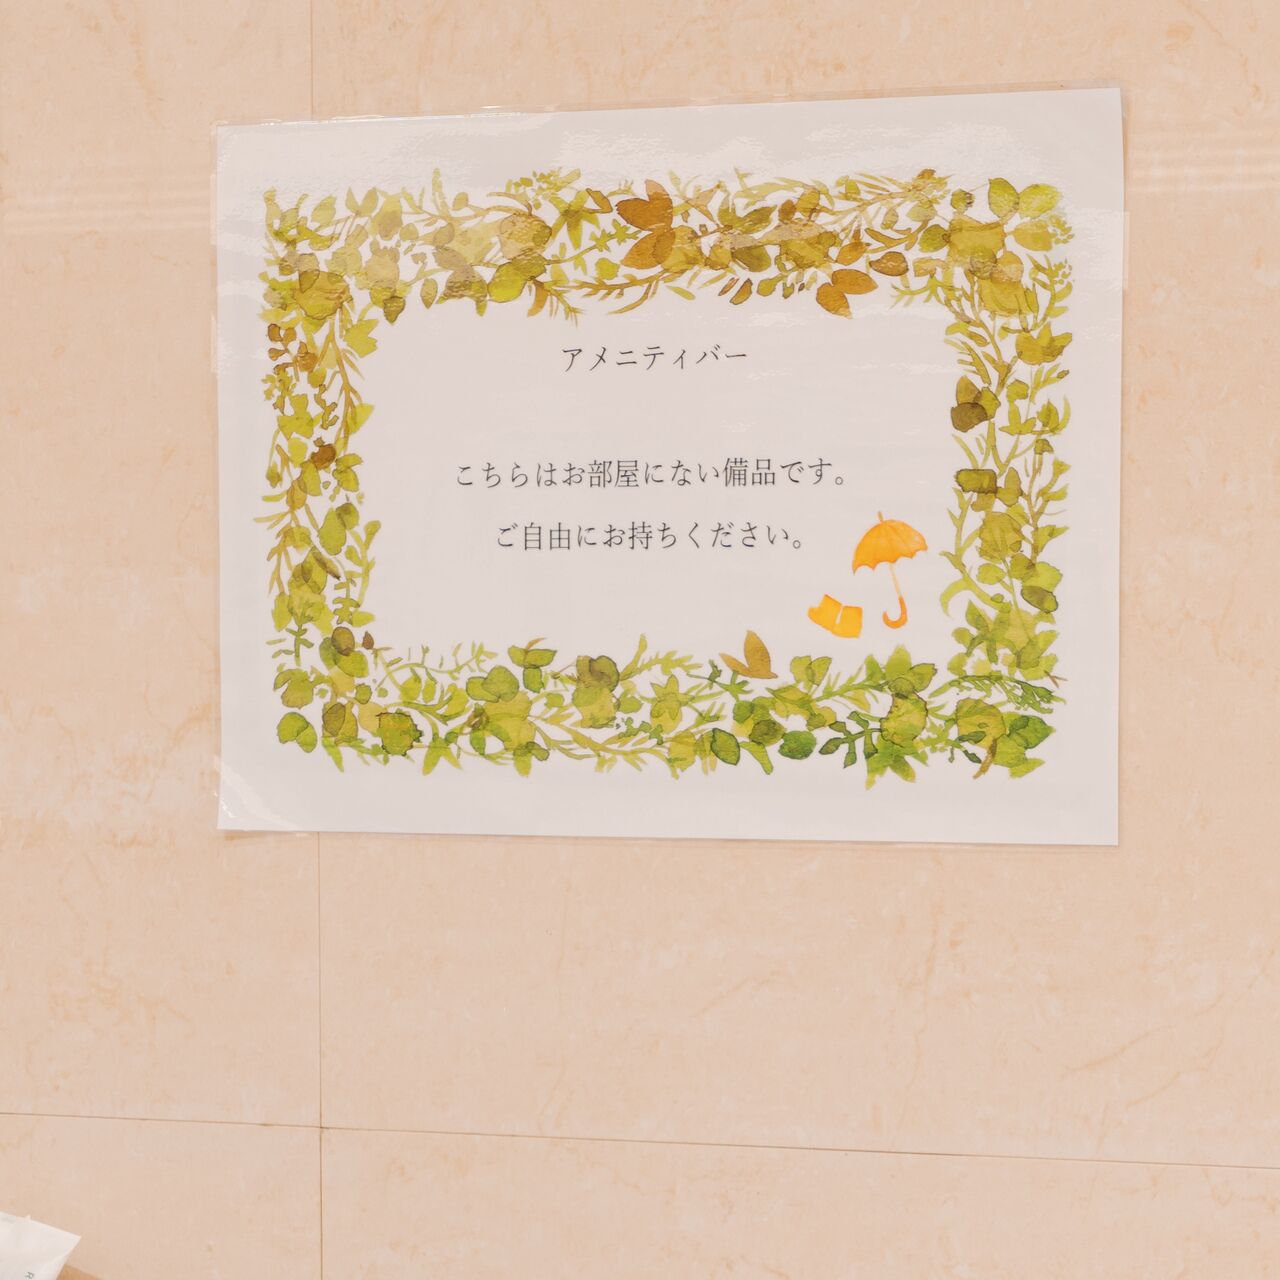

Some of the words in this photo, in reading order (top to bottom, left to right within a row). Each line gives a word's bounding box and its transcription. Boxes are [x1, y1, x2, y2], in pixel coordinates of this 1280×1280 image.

[561, 343, 747, 373] アメニティバー
[455, 457, 845, 489] こちらはお部屋にない備品です。
[495, 520, 803, 551] ご自由にお持ちください。
